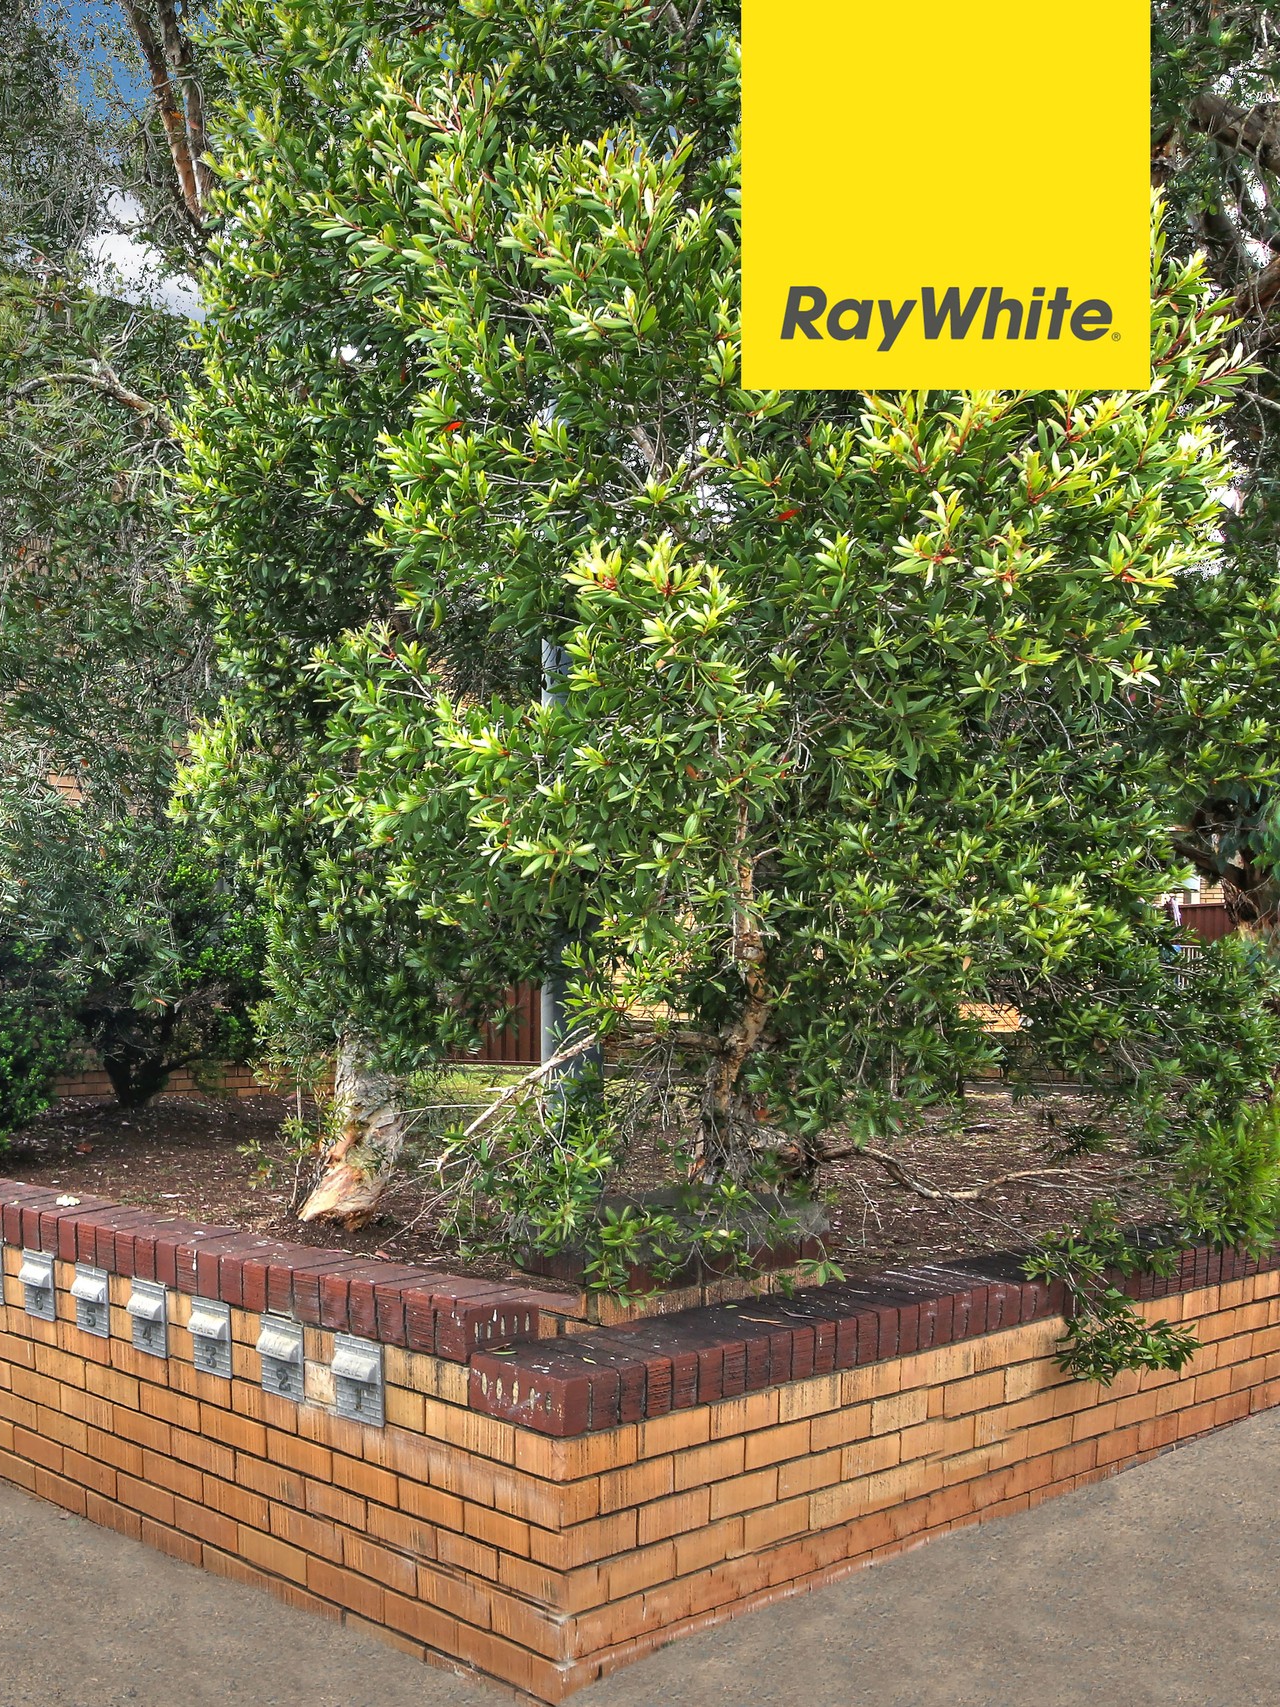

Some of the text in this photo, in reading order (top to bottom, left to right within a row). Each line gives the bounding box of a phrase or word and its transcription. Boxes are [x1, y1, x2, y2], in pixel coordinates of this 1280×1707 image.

[86, 1305, 97, 1328] 5
[142, 1324, 153, 1347] 4
[205, 1345, 218, 1369] 3
[276, 1367, 291, 1392] 2
